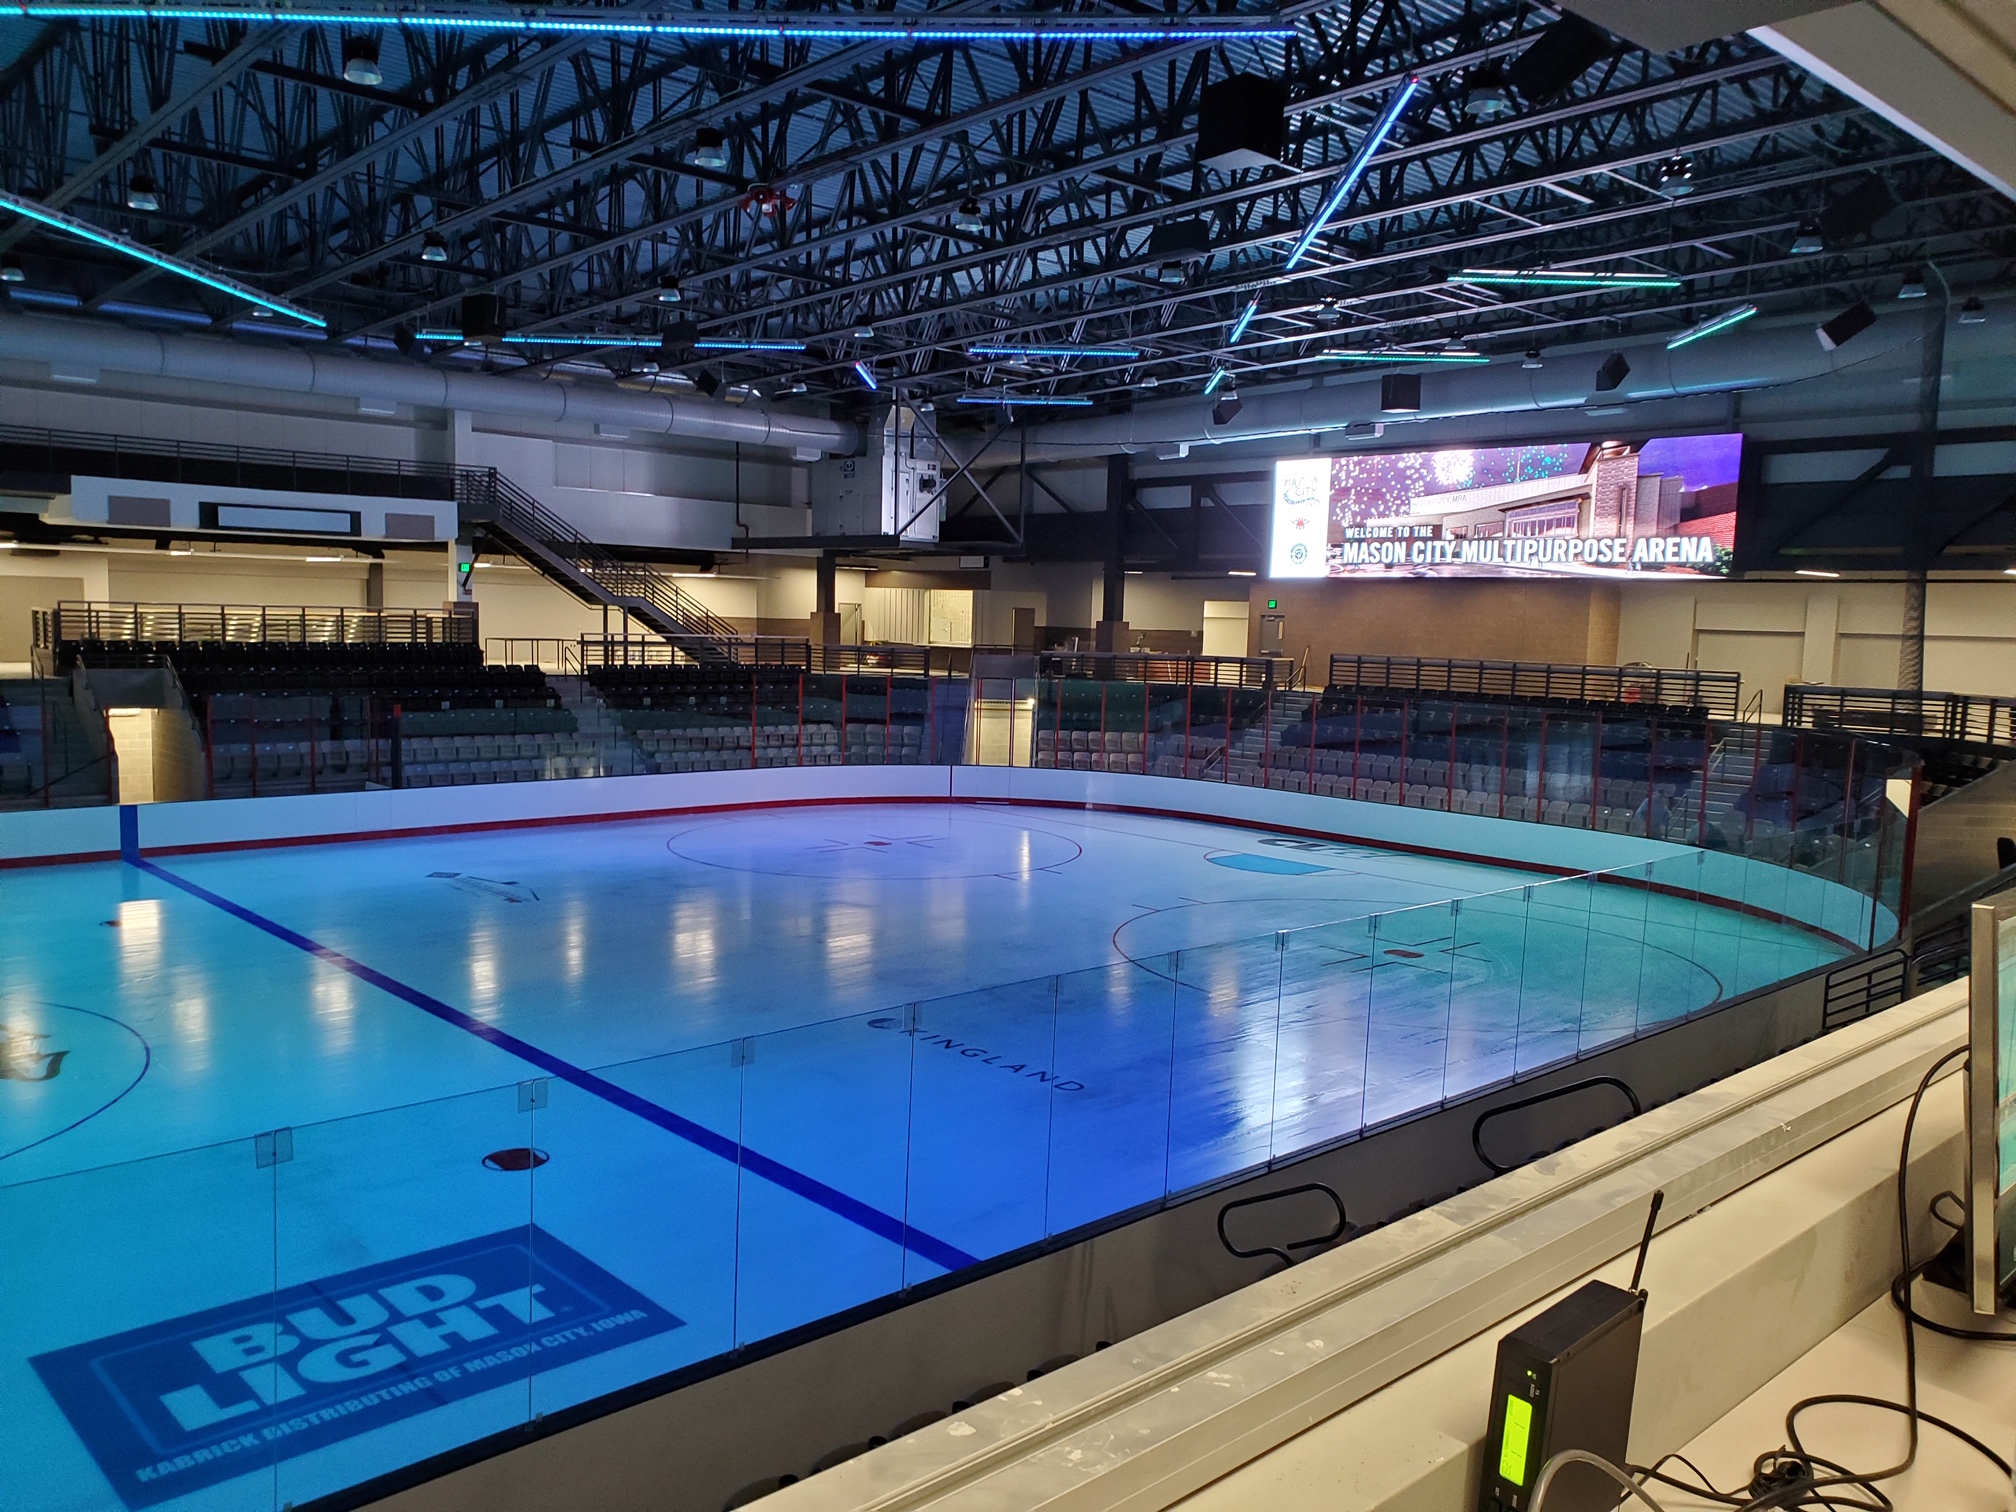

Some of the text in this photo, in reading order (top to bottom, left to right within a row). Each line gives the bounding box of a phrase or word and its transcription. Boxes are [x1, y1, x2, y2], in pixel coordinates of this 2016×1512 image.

[1343, 537, 1714, 565] MASON CITY MULTIPURPOSE ARENA
[1345, 525, 1433, 539] WELCOME TO THE
[899, 1027, 1085, 1092] KINGLAND
[159, 1284, 556, 1432] LIGHT
[190, 1274, 477, 1374] BUD
[135, 1308, 648, 1482] KABRICK DISTRIBUTING OF MASON CITY, IOWA
